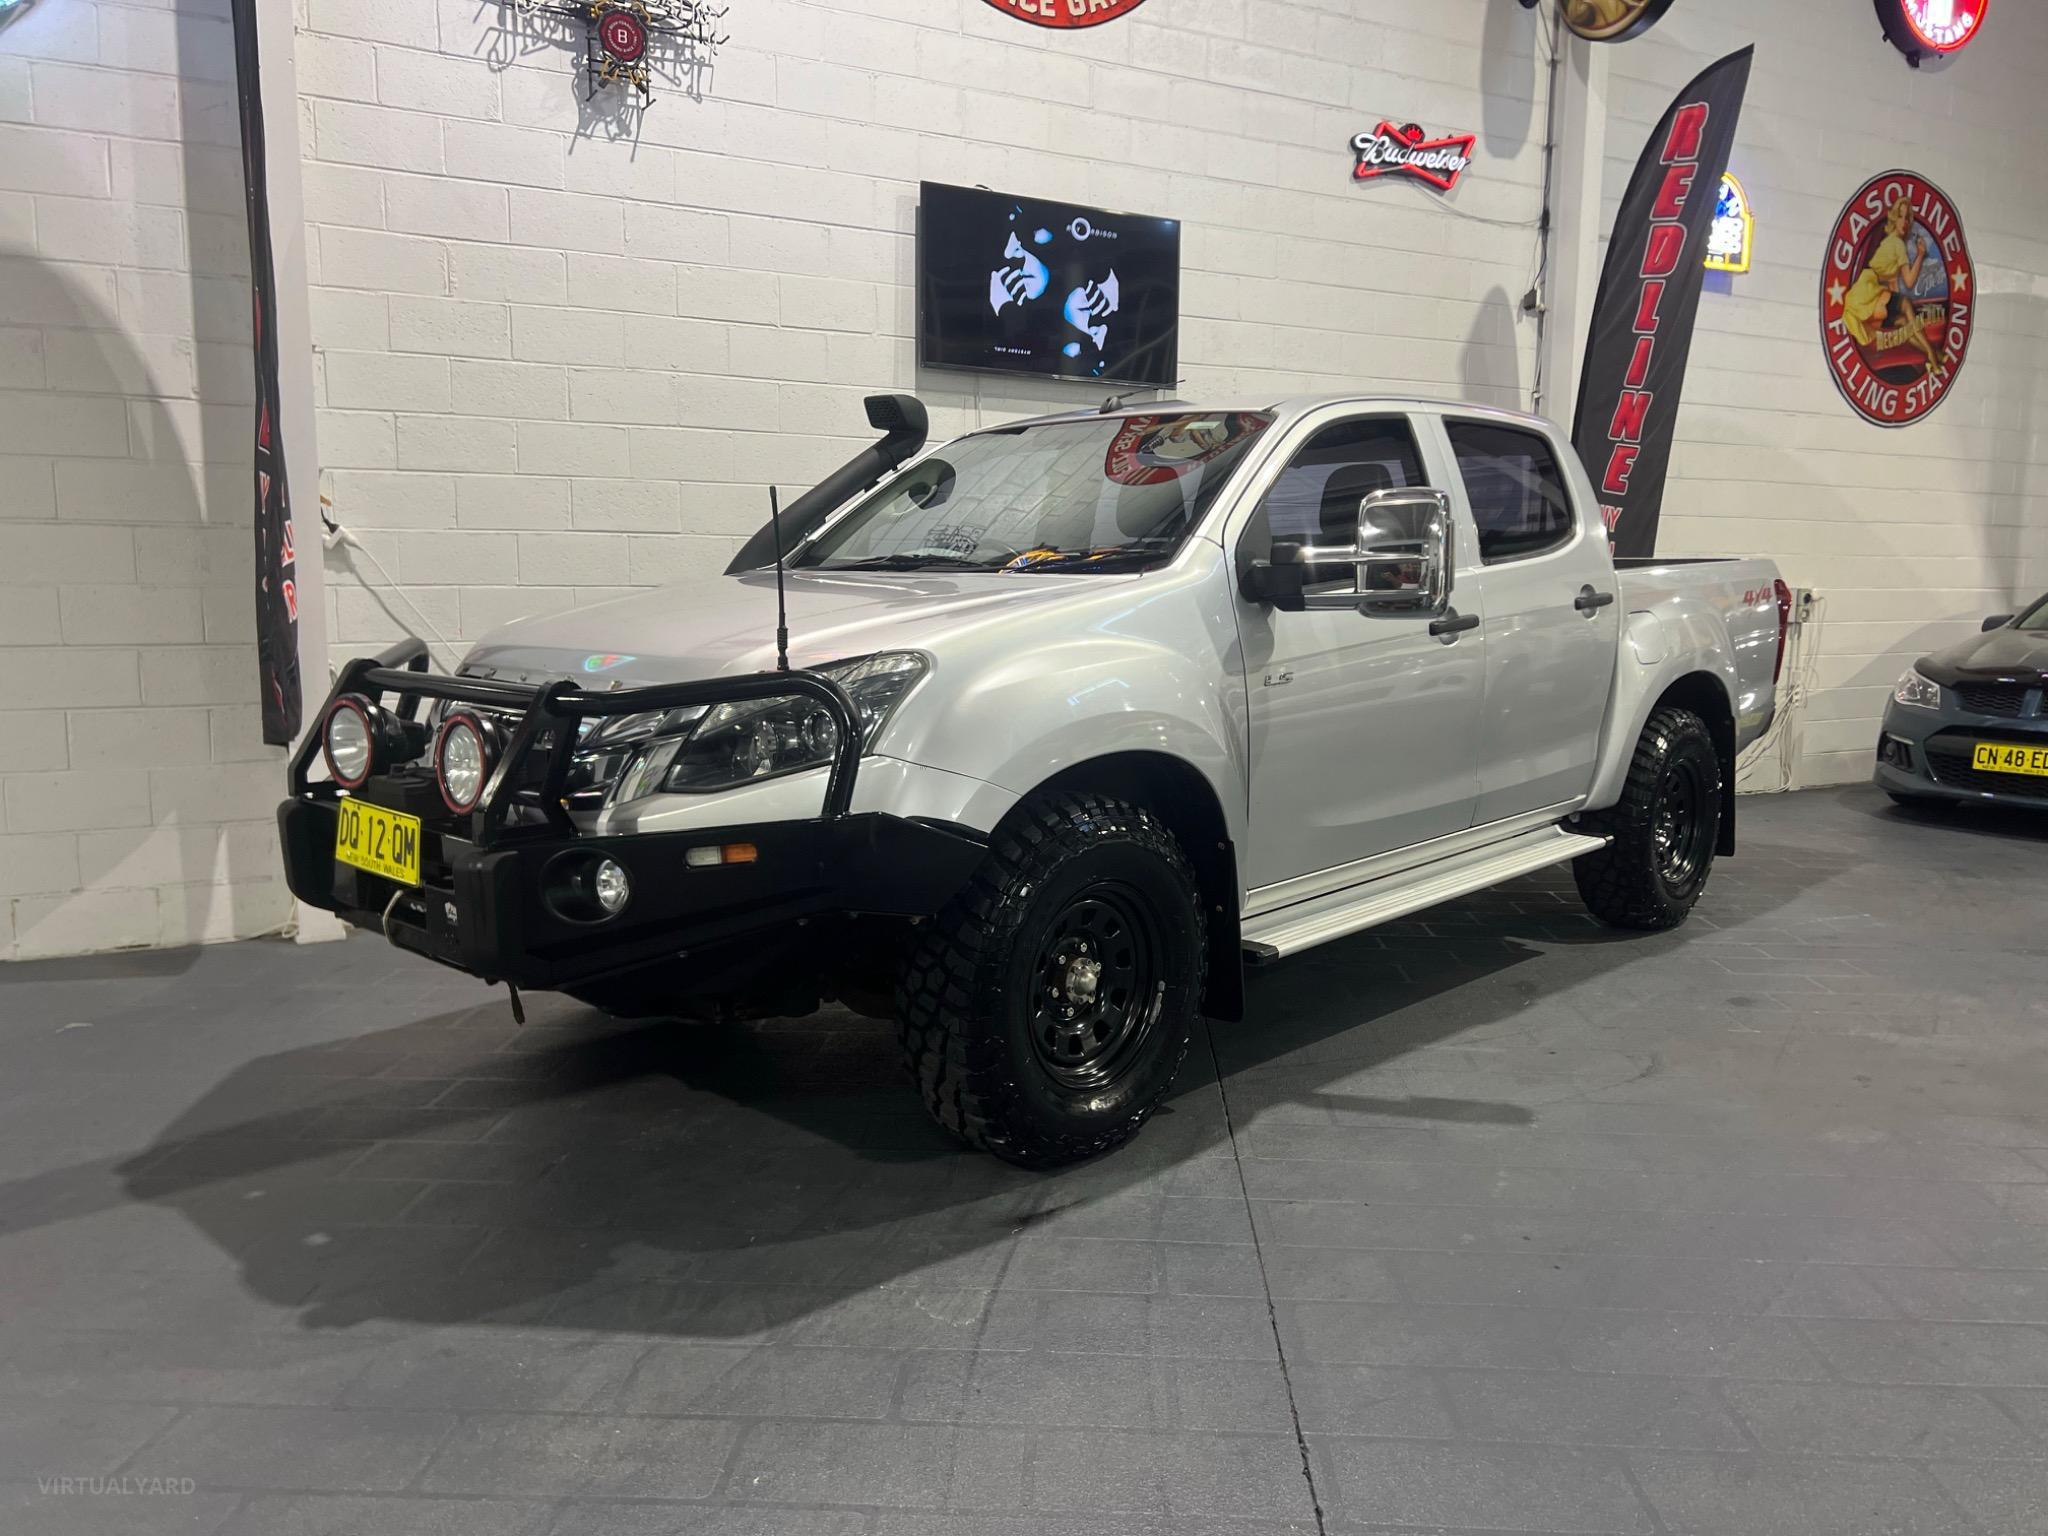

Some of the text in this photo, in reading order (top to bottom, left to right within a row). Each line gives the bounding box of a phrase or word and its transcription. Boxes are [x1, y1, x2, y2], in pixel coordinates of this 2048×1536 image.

[1355, 132, 1467, 172] Budweiser
[1834, 182, 1961, 270] GASOLINE
[1602, 102, 1709, 496] REDLINE
[1829, 318, 1898, 416] FILLING
[1904, 303, 1969, 414] STATION
[1977, 747, 1998, 765] CN
[2003, 749, 2026, 767] 48
[367, 815, 386, 861] 12
[392, 824, 415, 869] QM
